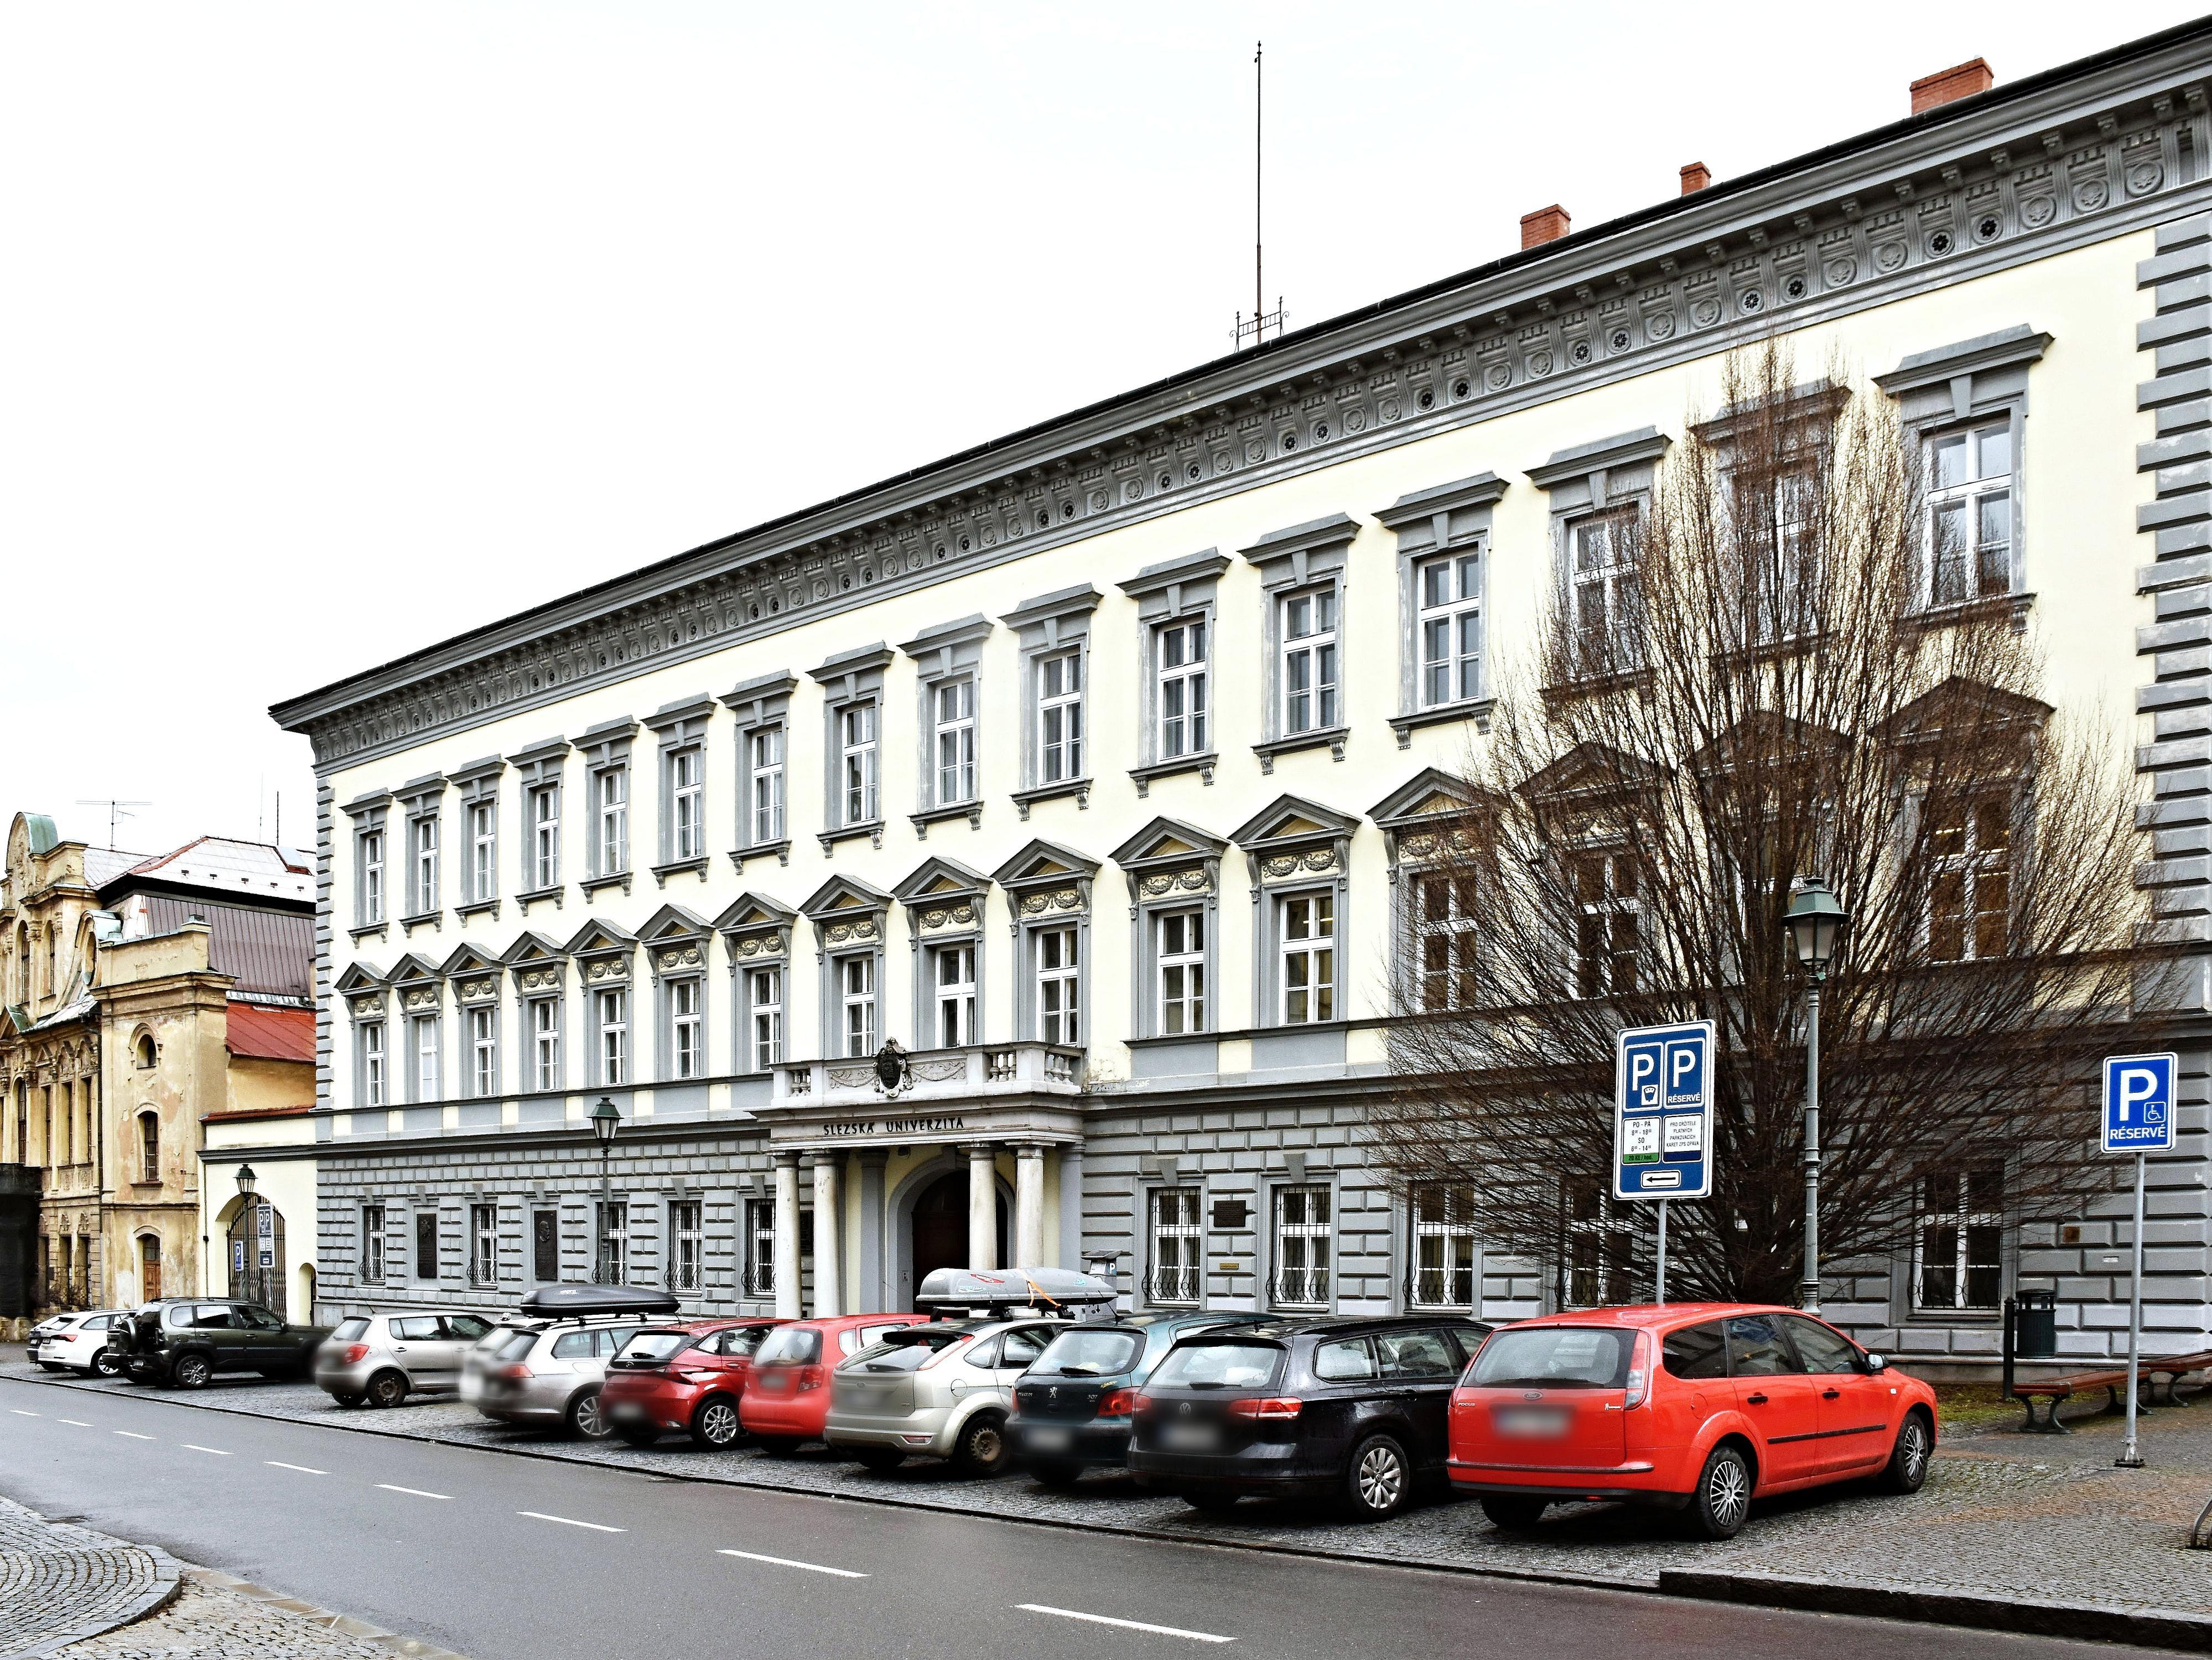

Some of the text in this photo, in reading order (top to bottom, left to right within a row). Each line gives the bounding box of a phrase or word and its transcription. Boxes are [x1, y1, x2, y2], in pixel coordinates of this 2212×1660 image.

[1632, 1054, 1654, 1091] P
[1673, 1050, 1696, 1087] P
[1668, 1092, 1701, 1104] RÉSERVÉ
[2120, 1068, 2157, 1121] P
[886, 1116, 964, 1132] UNIVERZITA
[2110, 1124, 2166, 1140] RÉSERVÉ
[236, 1246, 240, 1262] P
[1109, 1263, 1115, 1274] P
